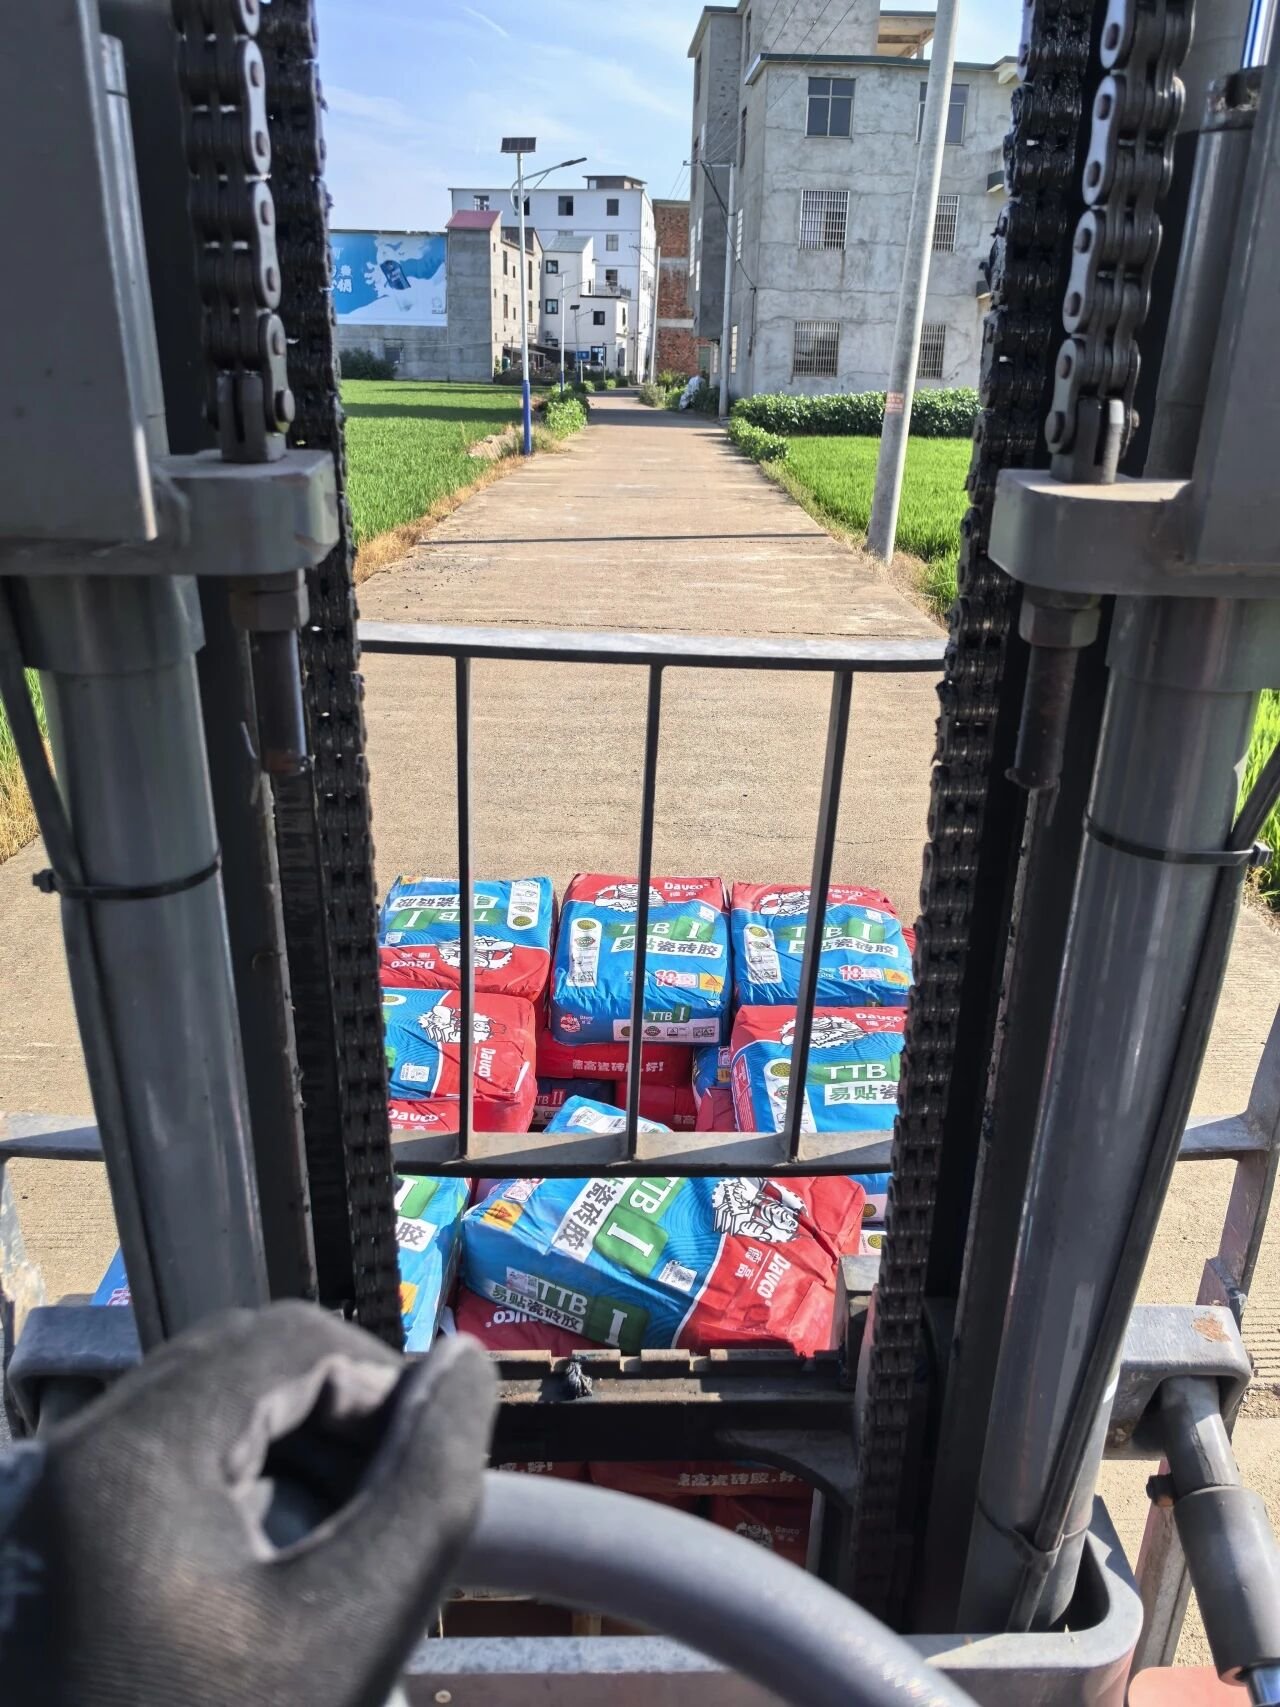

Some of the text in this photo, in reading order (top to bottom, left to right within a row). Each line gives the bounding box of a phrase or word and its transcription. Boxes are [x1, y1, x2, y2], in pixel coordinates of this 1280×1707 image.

[439, 911, 489, 922] TB
[620, 922, 670, 935] TB
[791, 926, 843, 938] TB
[651, 1011, 673, 1021] TTB
[824, 1063, 888, 1080] TTB
[397, 1221, 426, 1246] 胶
[537, 1278, 588, 1316] TTB
[493, 1284, 580, 1331] 易贴瓷砖胶
